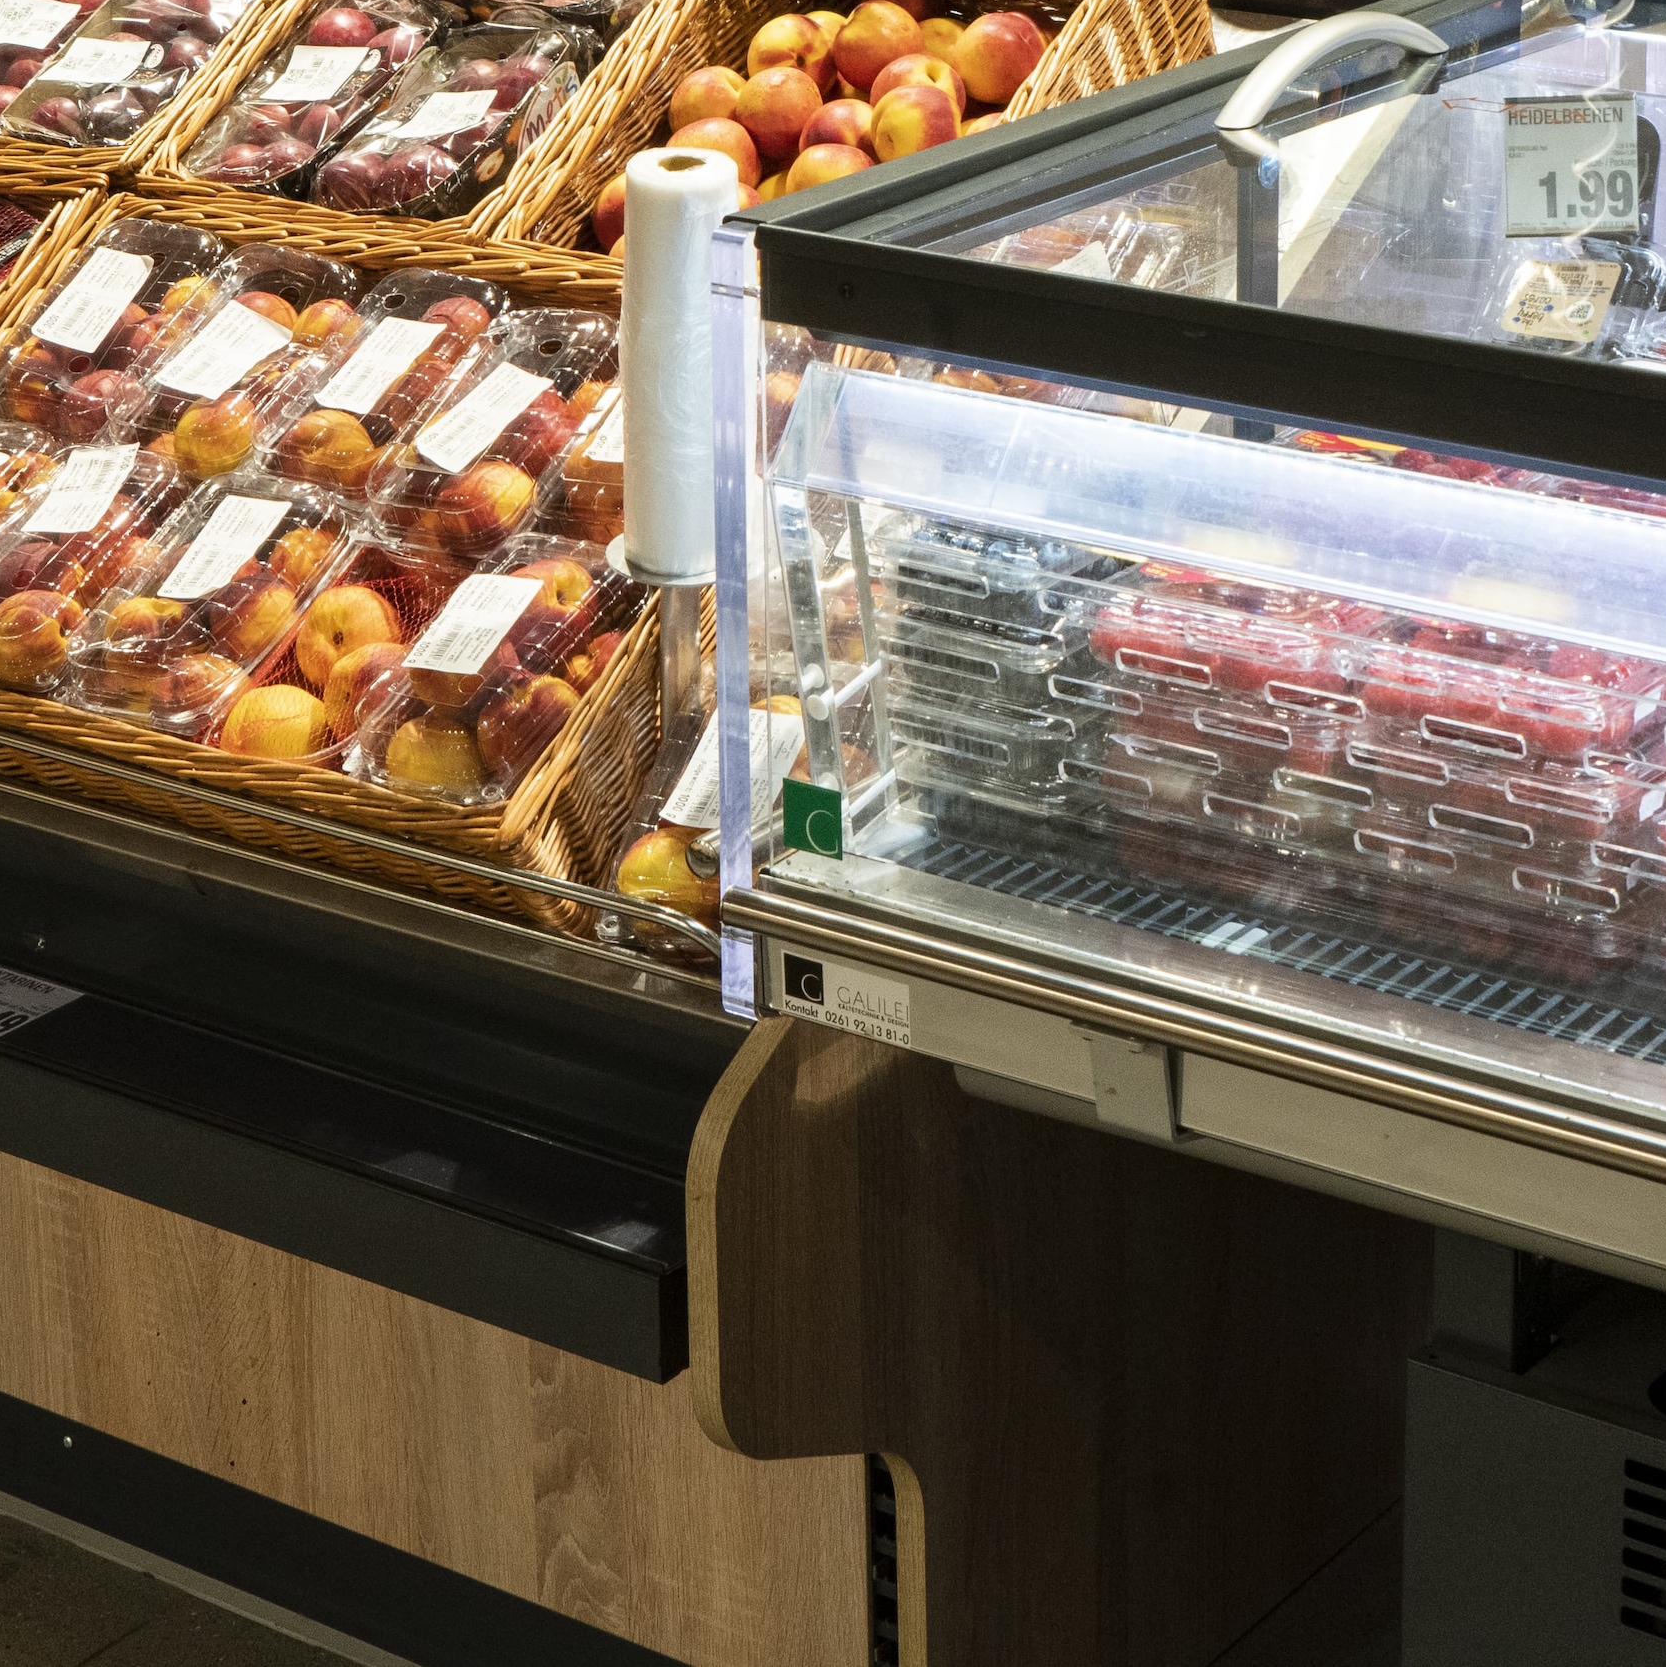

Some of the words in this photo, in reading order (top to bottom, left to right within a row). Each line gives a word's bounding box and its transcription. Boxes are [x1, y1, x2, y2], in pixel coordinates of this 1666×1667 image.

[1507, 105, 1623, 128] HEIDELBEEREN
[1538, 169, 1635, 220] 1.99
[784, 999, 820, 1018] Kontakt
[824, 1010, 850, 1028] 0261
[853, 1018, 868, 1034] 92
[870, 1023, 883, 1038] 13
[885, 1027, 910, 1047] 81-0
[836, 984, 910, 1023] GALILEI
[887, 1017, 910, 1029] DESIGN
